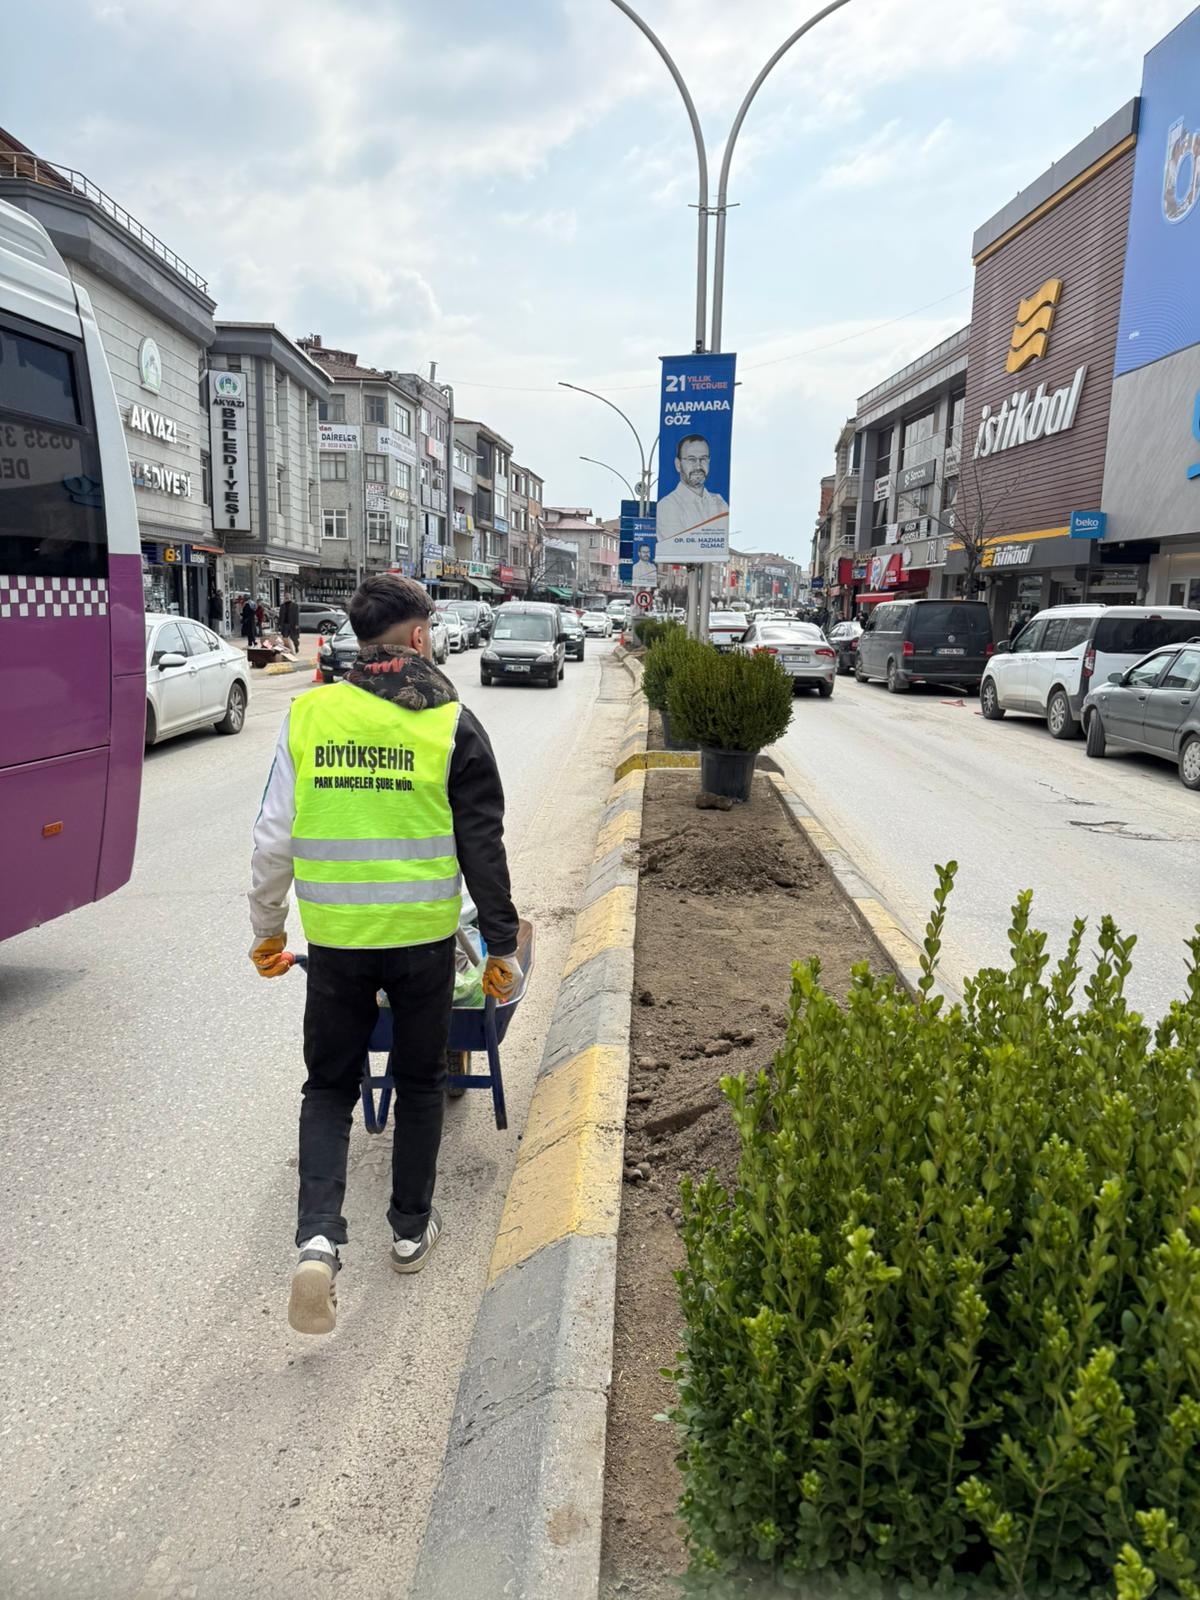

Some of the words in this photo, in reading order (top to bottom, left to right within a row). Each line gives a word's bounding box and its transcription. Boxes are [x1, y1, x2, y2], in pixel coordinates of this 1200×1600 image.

[665, 375, 686, 392] 21
[212, 399, 244, 408] AKYAZI
[665, 400, 730, 412] MARMARA
[665, 412, 691, 425] GÖZ
[972, 365, 1088, 460] istikbal
[131, 404, 177, 443] AKYAZI
[222, 408, 240, 528] BELEDİYESİ
[1075, 518, 1099, 527] beko
[993, 543, 1034, 566] istikbal
[315, 740, 415, 774] BÜYÜKŞEHİR
[314, 776, 333, 788] PARK
[334, 776, 374, 792] BAHÇELER
[375, 777, 394, 792] ŞUBE
[395, 777, 415, 791] MÜD.
